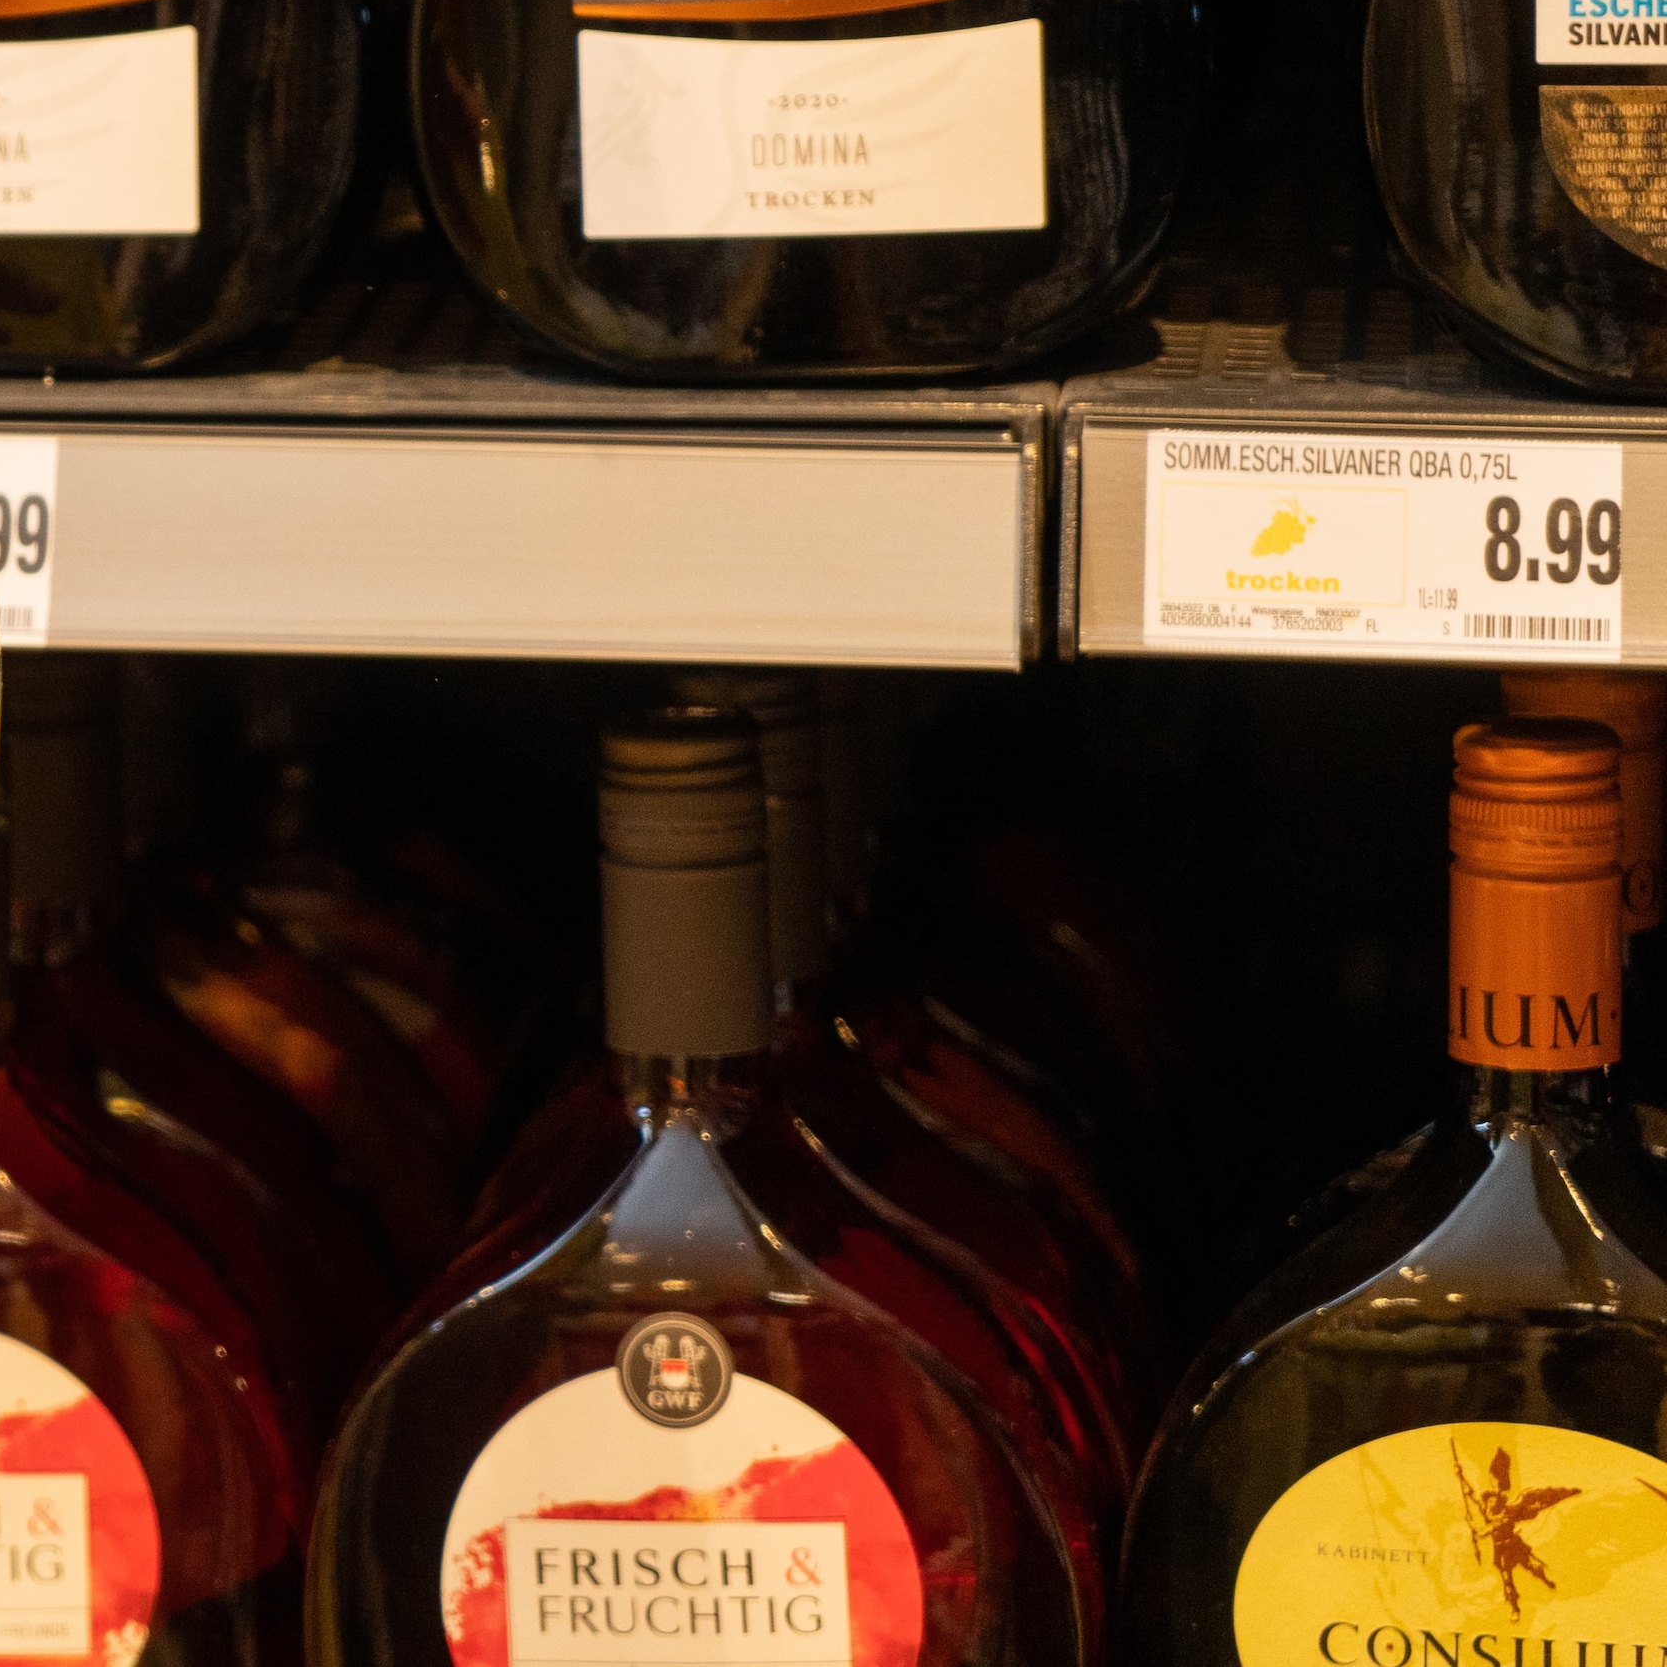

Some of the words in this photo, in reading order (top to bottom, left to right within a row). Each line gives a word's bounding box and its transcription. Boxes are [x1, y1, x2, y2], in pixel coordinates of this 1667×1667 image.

[752, 133, 868, 167] DOMINA
[745, 190, 875, 208] TROCKEN
[1164, 441, 1400, 477] SOMM.ESCH.SILVANER
[1409, 449, 1453, 479] QBA
[1459, 452, 1518, 485] 0,75L
[1484, 494, 1621, 585] 8.99
[1226, 569, 1339, 592] trocken
[1418, 586, 1458, 610] 1L=11.99
[1366, 619, 1379, 633] FL
[647, 1391, 705, 1412] GWF
[27, 1499, 64, 1537] &
[534, 1547, 755, 1588] FRISCH
[784, 1546, 823, 1587] &
[1317, 1542, 1430, 1566] KABINETT
[538, 1594, 824, 1636] FRUCHTIG
